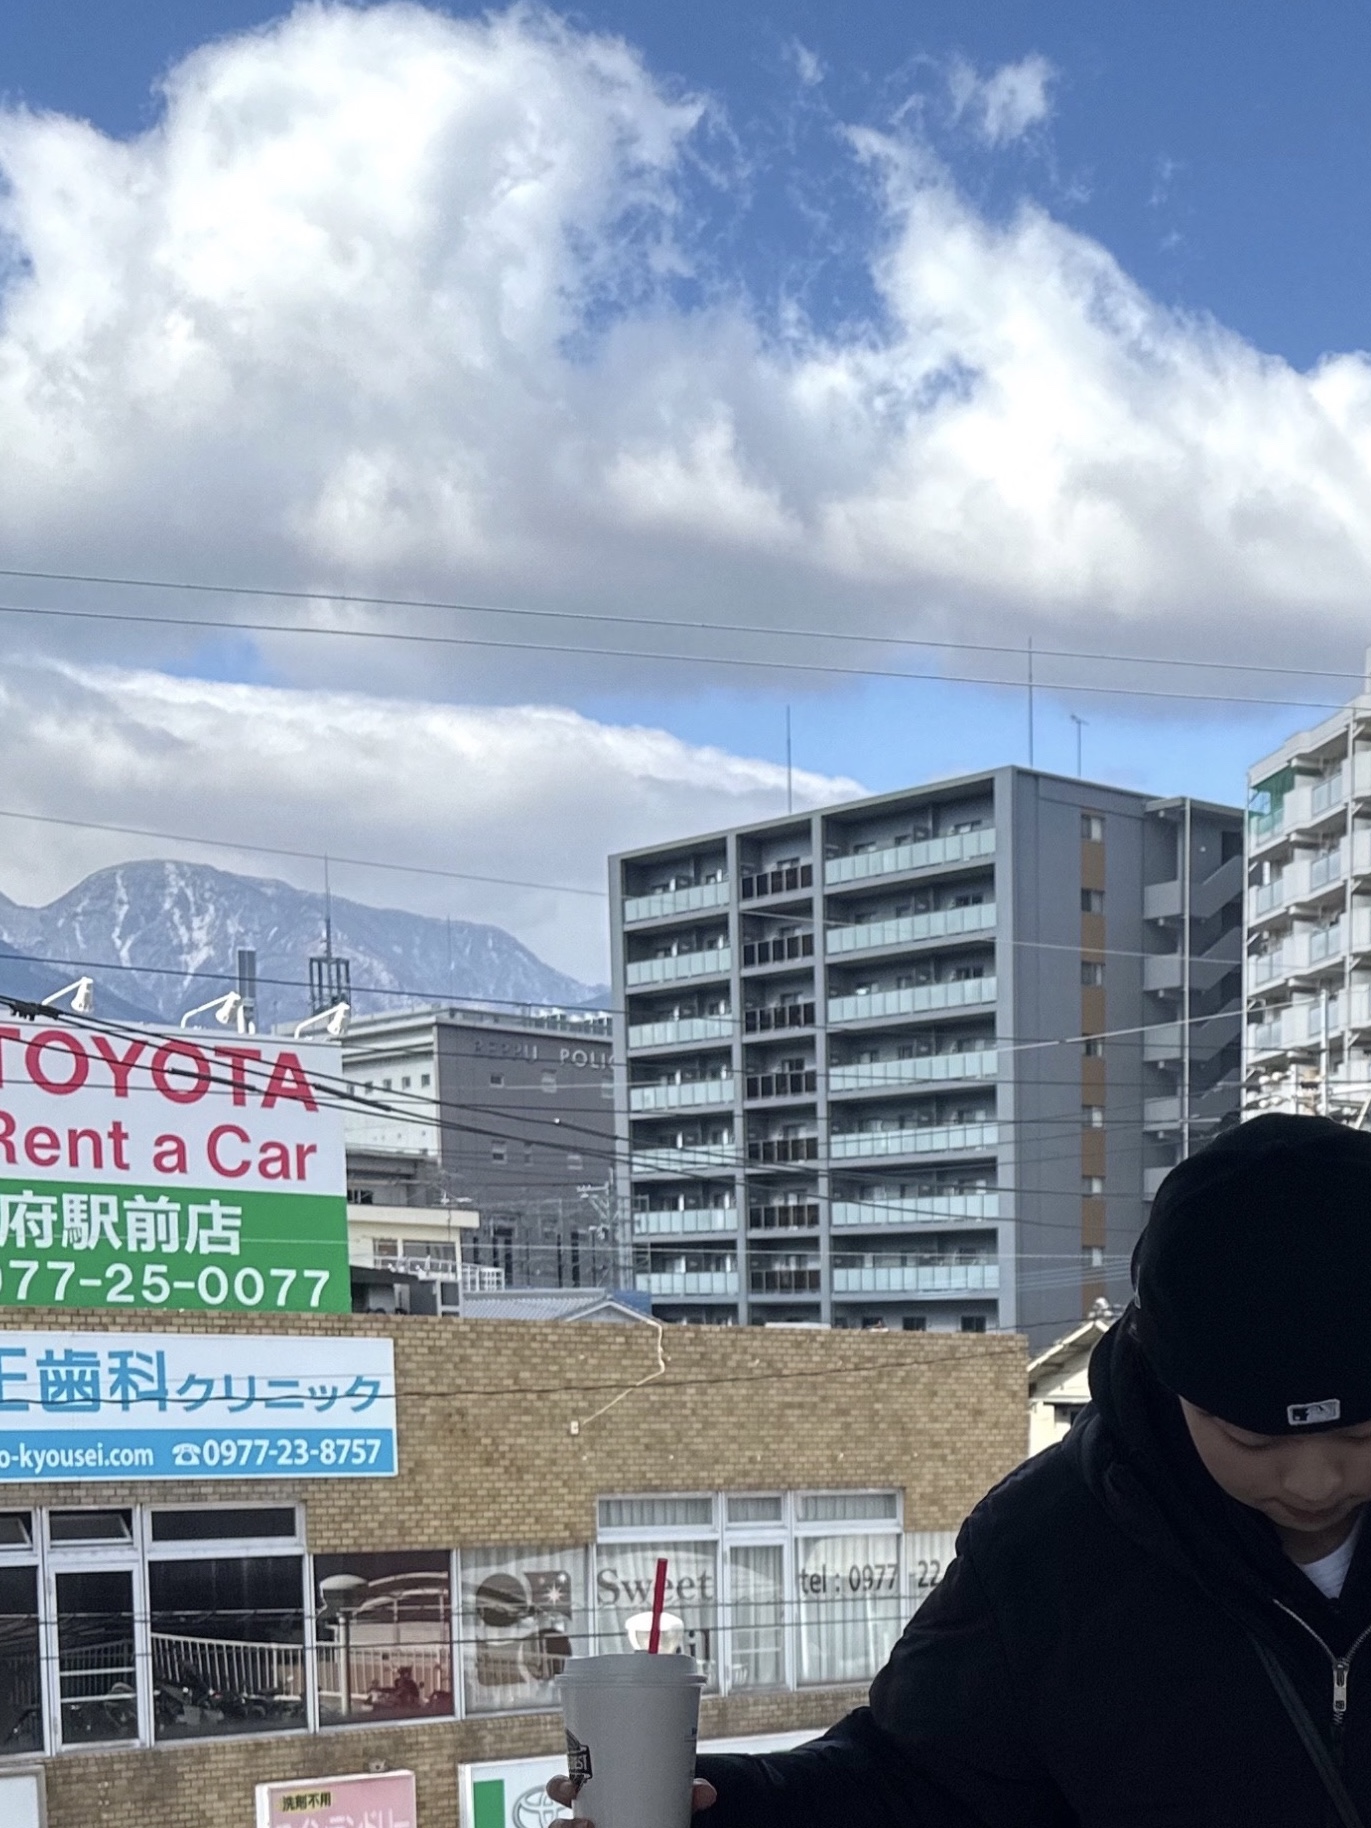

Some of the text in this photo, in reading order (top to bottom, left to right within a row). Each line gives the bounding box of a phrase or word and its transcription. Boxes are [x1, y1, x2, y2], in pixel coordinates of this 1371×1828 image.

[153, 1133, 188, 1175] a
[206, 1124, 318, 1181] Car
[0, 1259, 330, 1308] 77-25-0077
